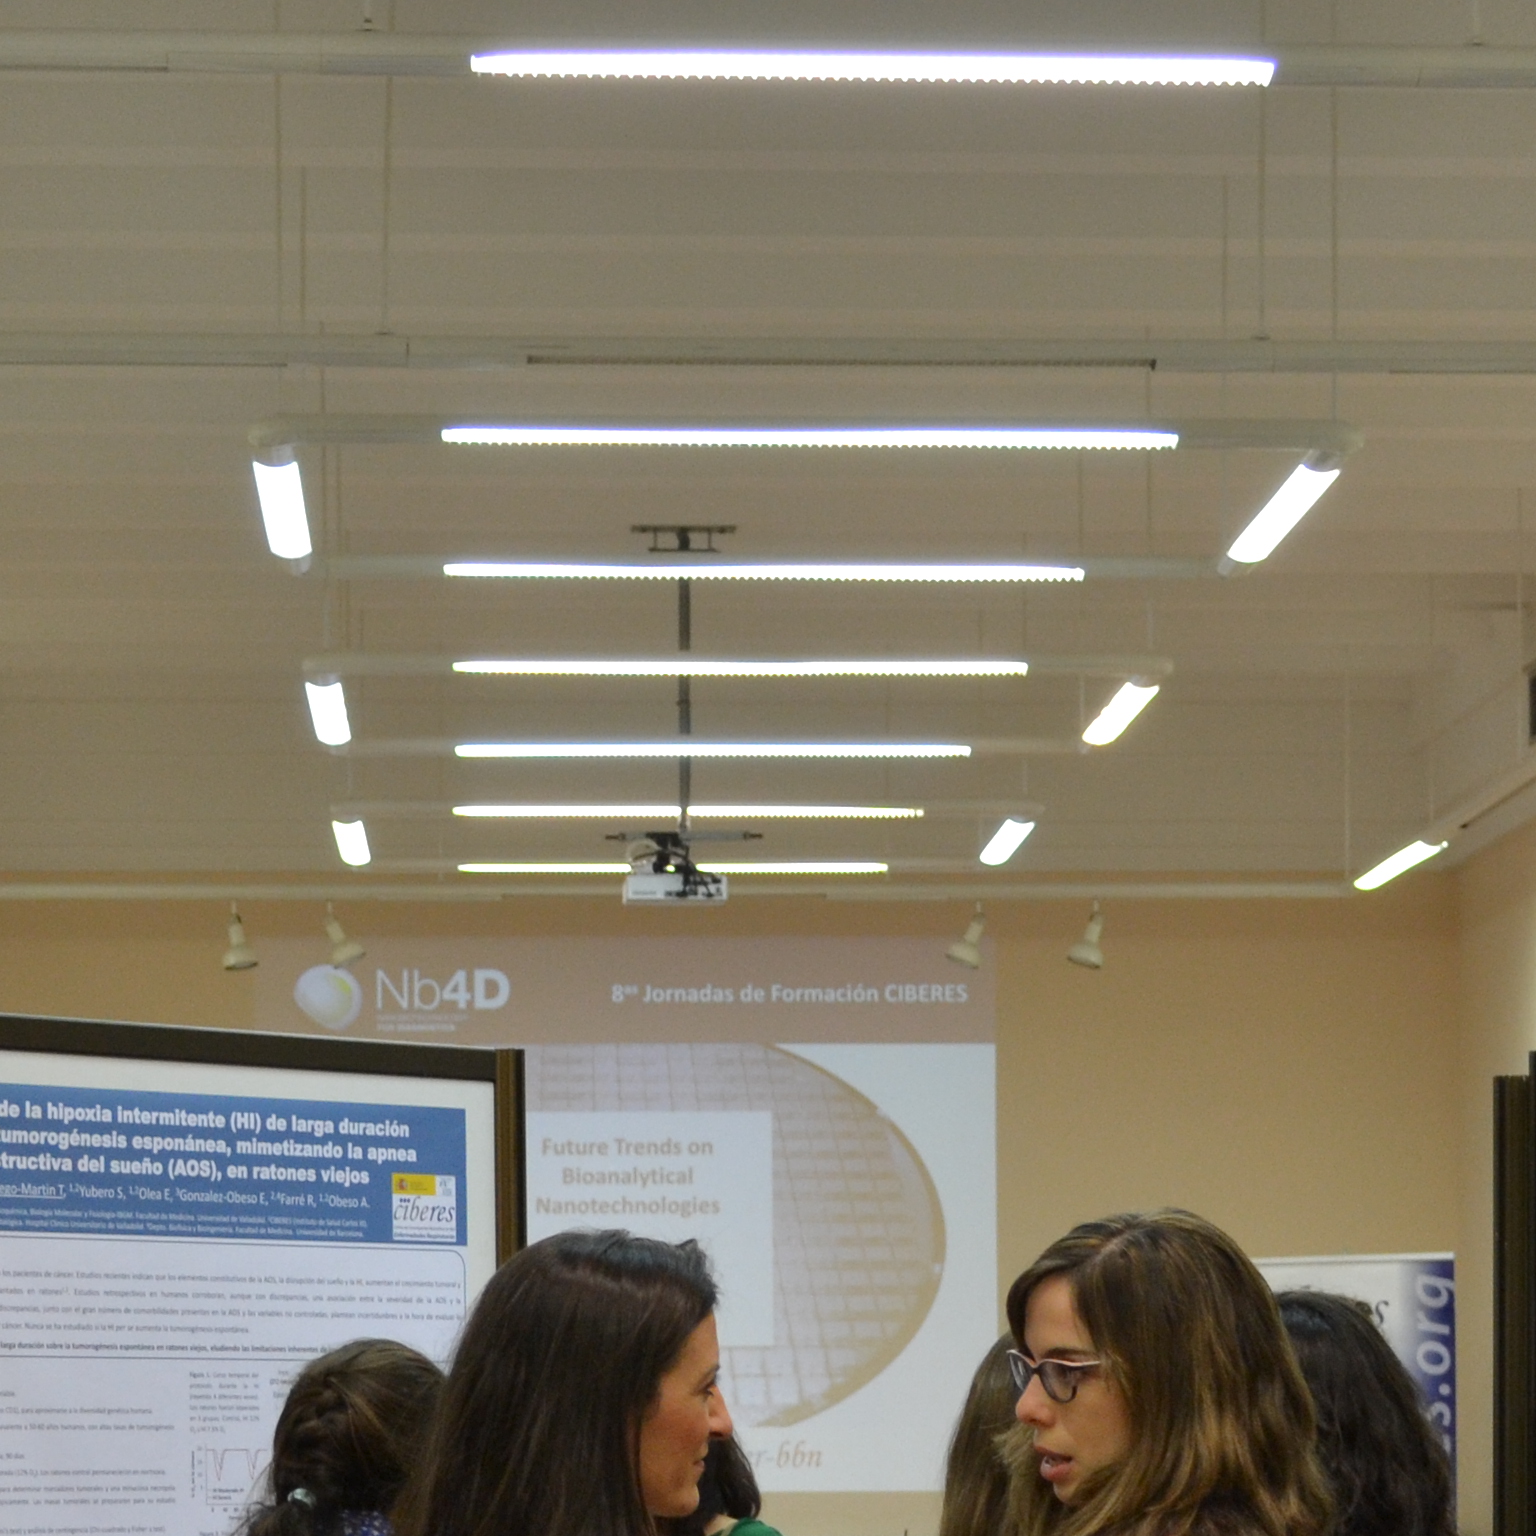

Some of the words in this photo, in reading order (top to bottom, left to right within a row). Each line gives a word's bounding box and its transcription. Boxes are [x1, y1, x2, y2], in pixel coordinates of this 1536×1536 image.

[376, 968, 511, 1011] Nb4D
[643, 983, 734, 1002] Jornadas
[740, 984, 765, 1002] de
[771, 983, 879, 1002] Formación
[884, 983, 968, 1002] CIBERES
[25, 1101, 42, 1119] la
[47, 1102, 113, 1124] hipoxia
[117, 1106, 226, 1129] intermitente
[230, 1112, 262, 1134] (HI)
[266, 1114, 288, 1132] de
[292, 1115, 334, 1137] larga
[339, 1118, 410, 1138] duración
[236, 1137, 343, 1160] mimetizando
[348, 1142, 363, 1160] la
[367, 1146, 417, 1165] apnea
[542, 1138, 608, 1156] Future
[614, 1137, 682, 1156] Trends
[688, 1140, 713, 1156] on
[78, 1154, 104, 1173] del
[110, 1156, 163, 1176] sueño
[168, 1159, 222, 1182] (AOS),
[227, 1164, 247, 1179] en
[253, 1164, 316, 1183] ratones
[321, 1166, 370, 1188] viejos
[562, 1167, 693, 1188] Bioanalytical
[536, 1197, 721, 1218] Nanotechnologies
